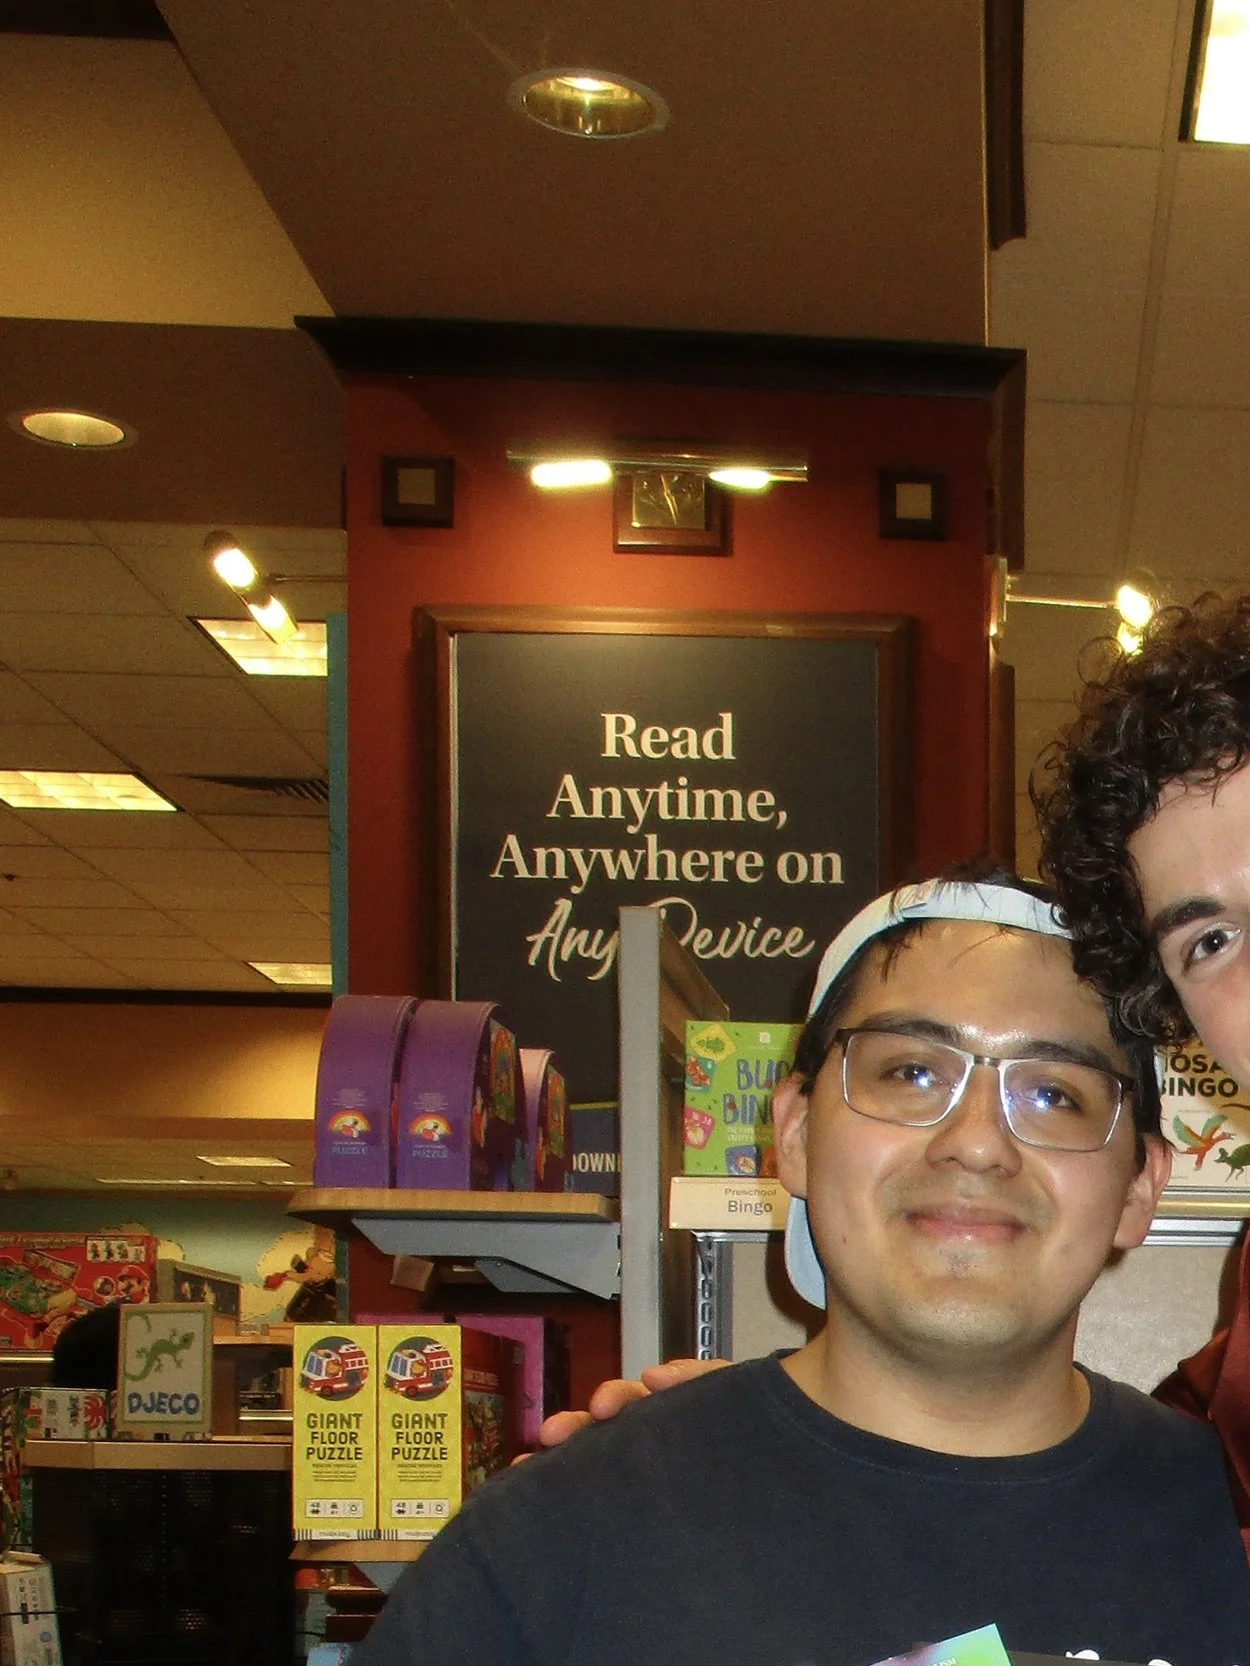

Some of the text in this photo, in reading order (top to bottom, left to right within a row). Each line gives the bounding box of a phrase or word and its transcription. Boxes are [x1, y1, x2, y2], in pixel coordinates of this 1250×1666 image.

[600, 712, 737, 761] Read
[546, 773, 788, 834] Anytime,
[489, 834, 845, 894] Anywhere on
[526, 896, 816, 981] Any Device
[572, 1152, 620, 1173] OWN
[724, 1187, 777, 1198] Preschool
[727, 1200, 774, 1216] Bingo
[126, 1391, 201, 1415] DJECO
[306, 1413, 363, 1429] GIANT
[392, 1413, 449, 1429] GIANT
[311, 1431, 359, 1445] FLOOR
[396, 1431, 444, 1445] FLOOR
[306, 1447, 363, 1461] PUZZLE
[391, 1447, 448, 1461] PUZZLE
